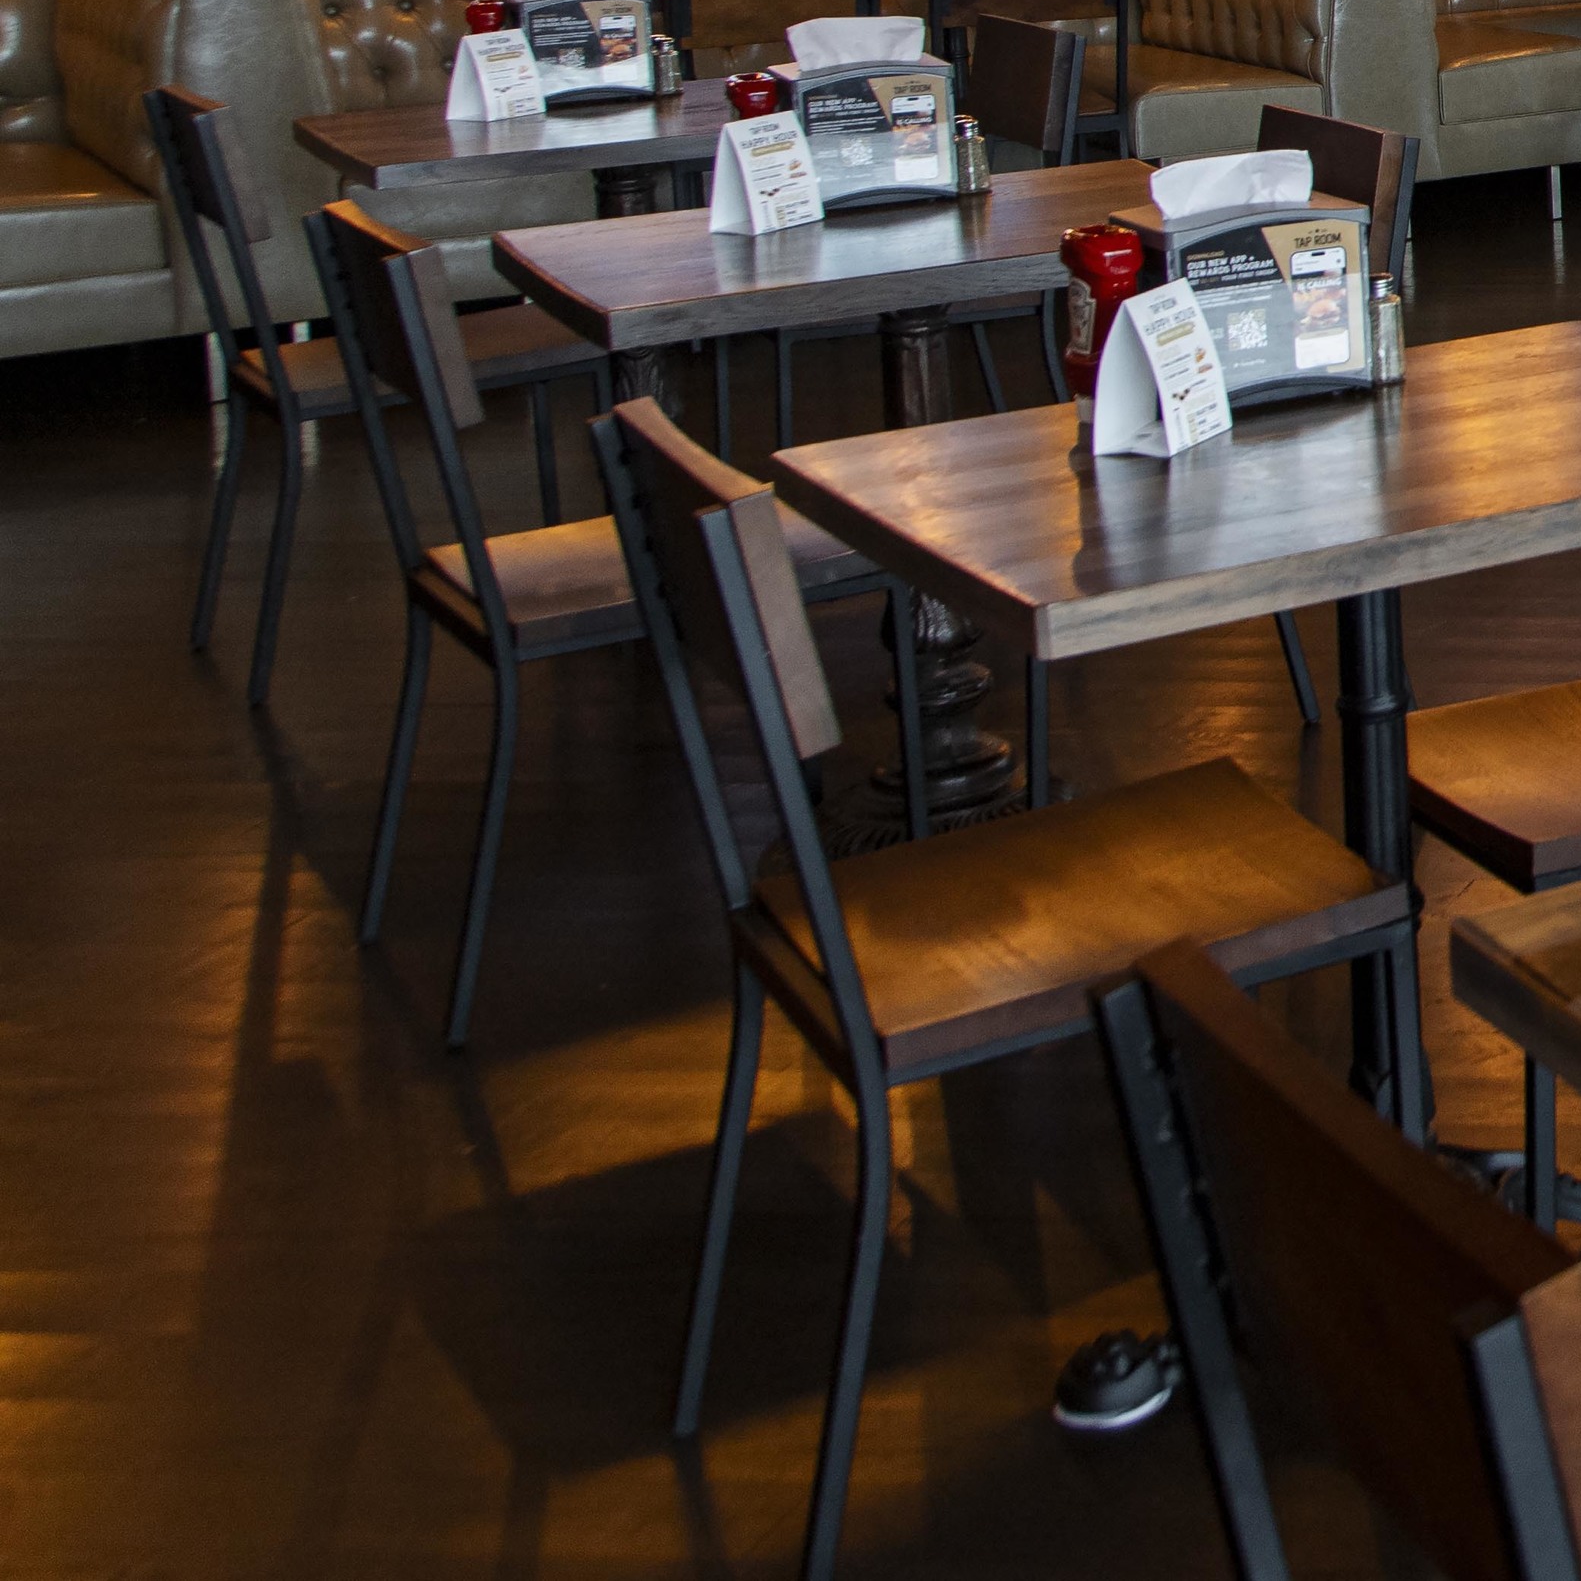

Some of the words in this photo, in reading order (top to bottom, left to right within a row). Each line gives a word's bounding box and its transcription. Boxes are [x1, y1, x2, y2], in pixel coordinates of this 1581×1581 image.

[1294, 236, 1311, 249] TAP
[1313, 233, 1342, 245] ROOM
[1187, 260, 1206, 270] OUR
[1208, 257, 1228, 267] NEW
[1230, 254, 1247, 265] APP
[1187, 266, 1230, 279] REWARDS
[1232, 259, 1274, 272] PROGRAM
